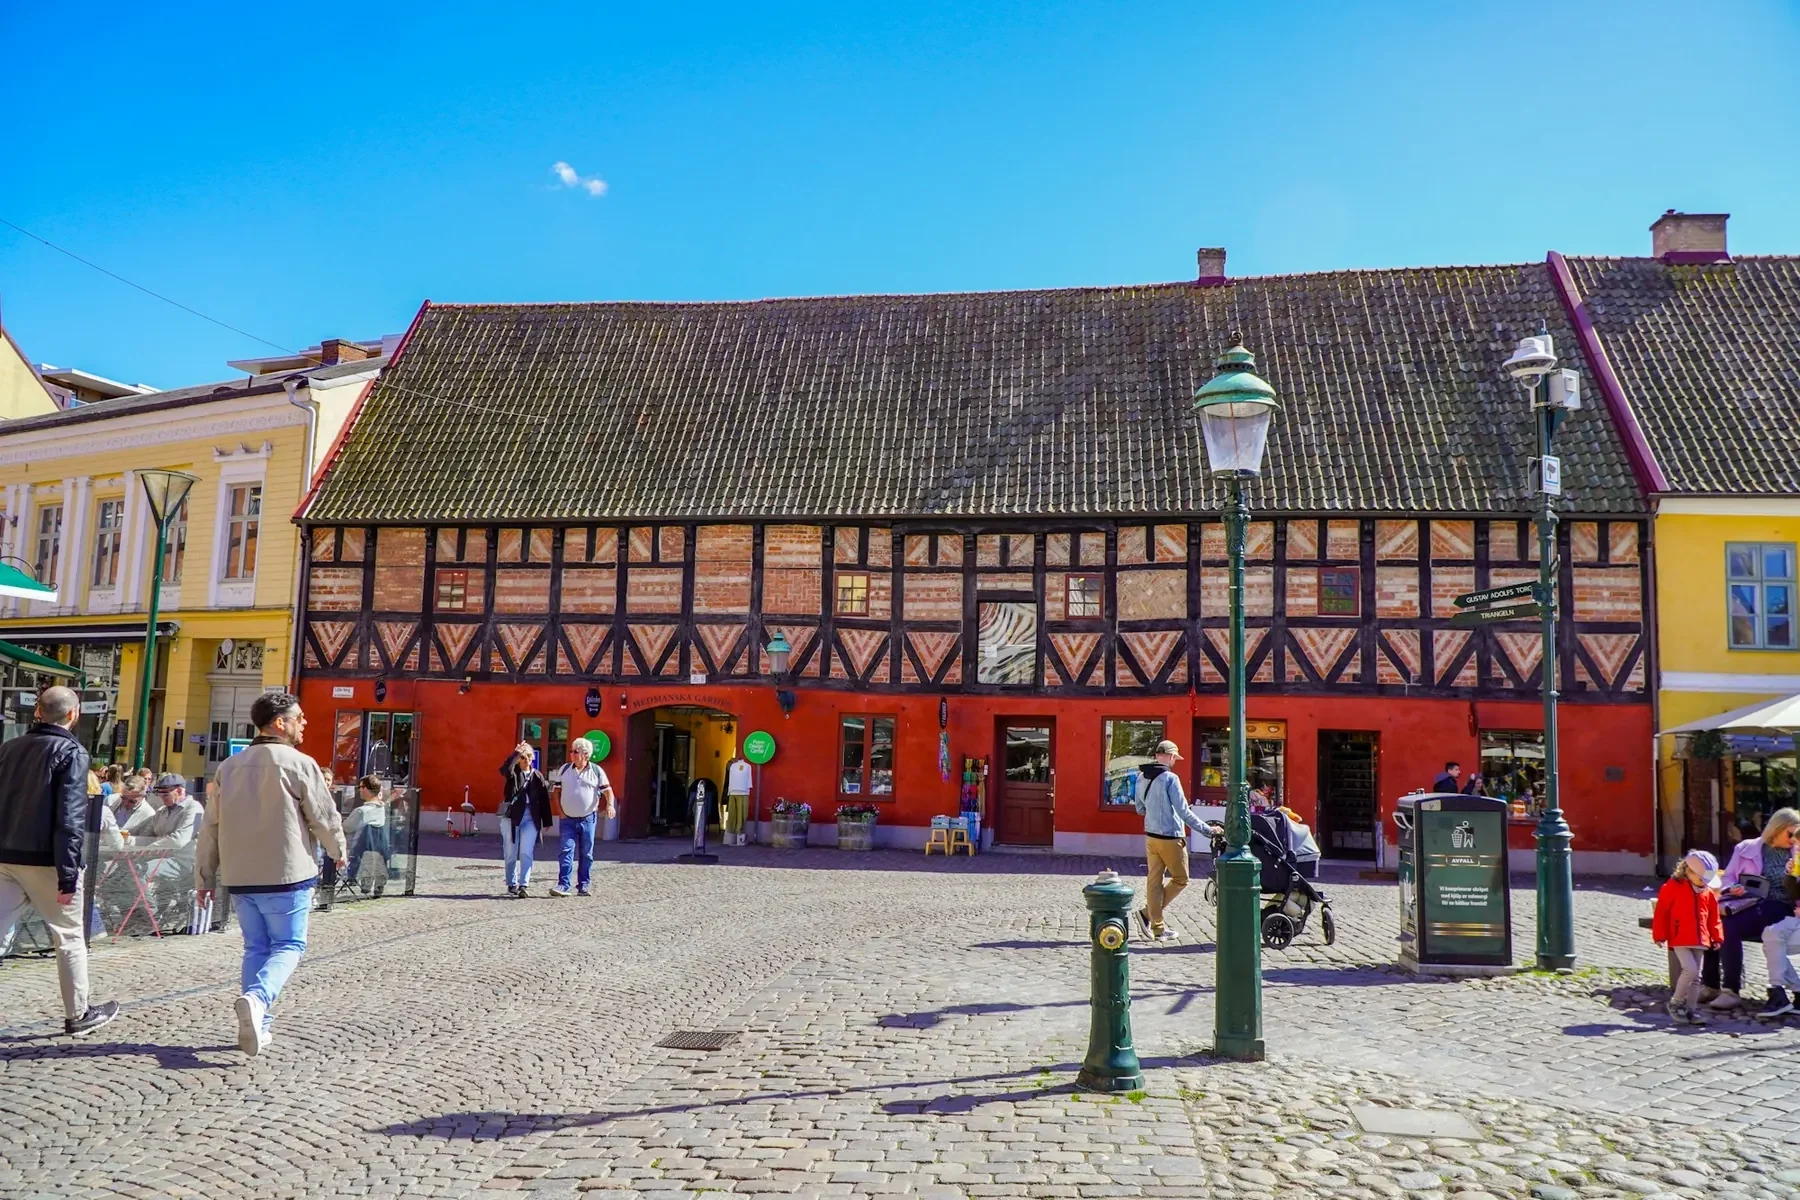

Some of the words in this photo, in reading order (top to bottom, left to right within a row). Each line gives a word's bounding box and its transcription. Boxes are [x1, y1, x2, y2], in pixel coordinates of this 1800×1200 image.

[1466, 594, 1489, 603] GUSTAV
[1490, 589, 1514, 599] ADOLFS
[1480, 609, 1515, 619] TRIANGELN
[633, 694, 693, 708] HEDMANSKA
